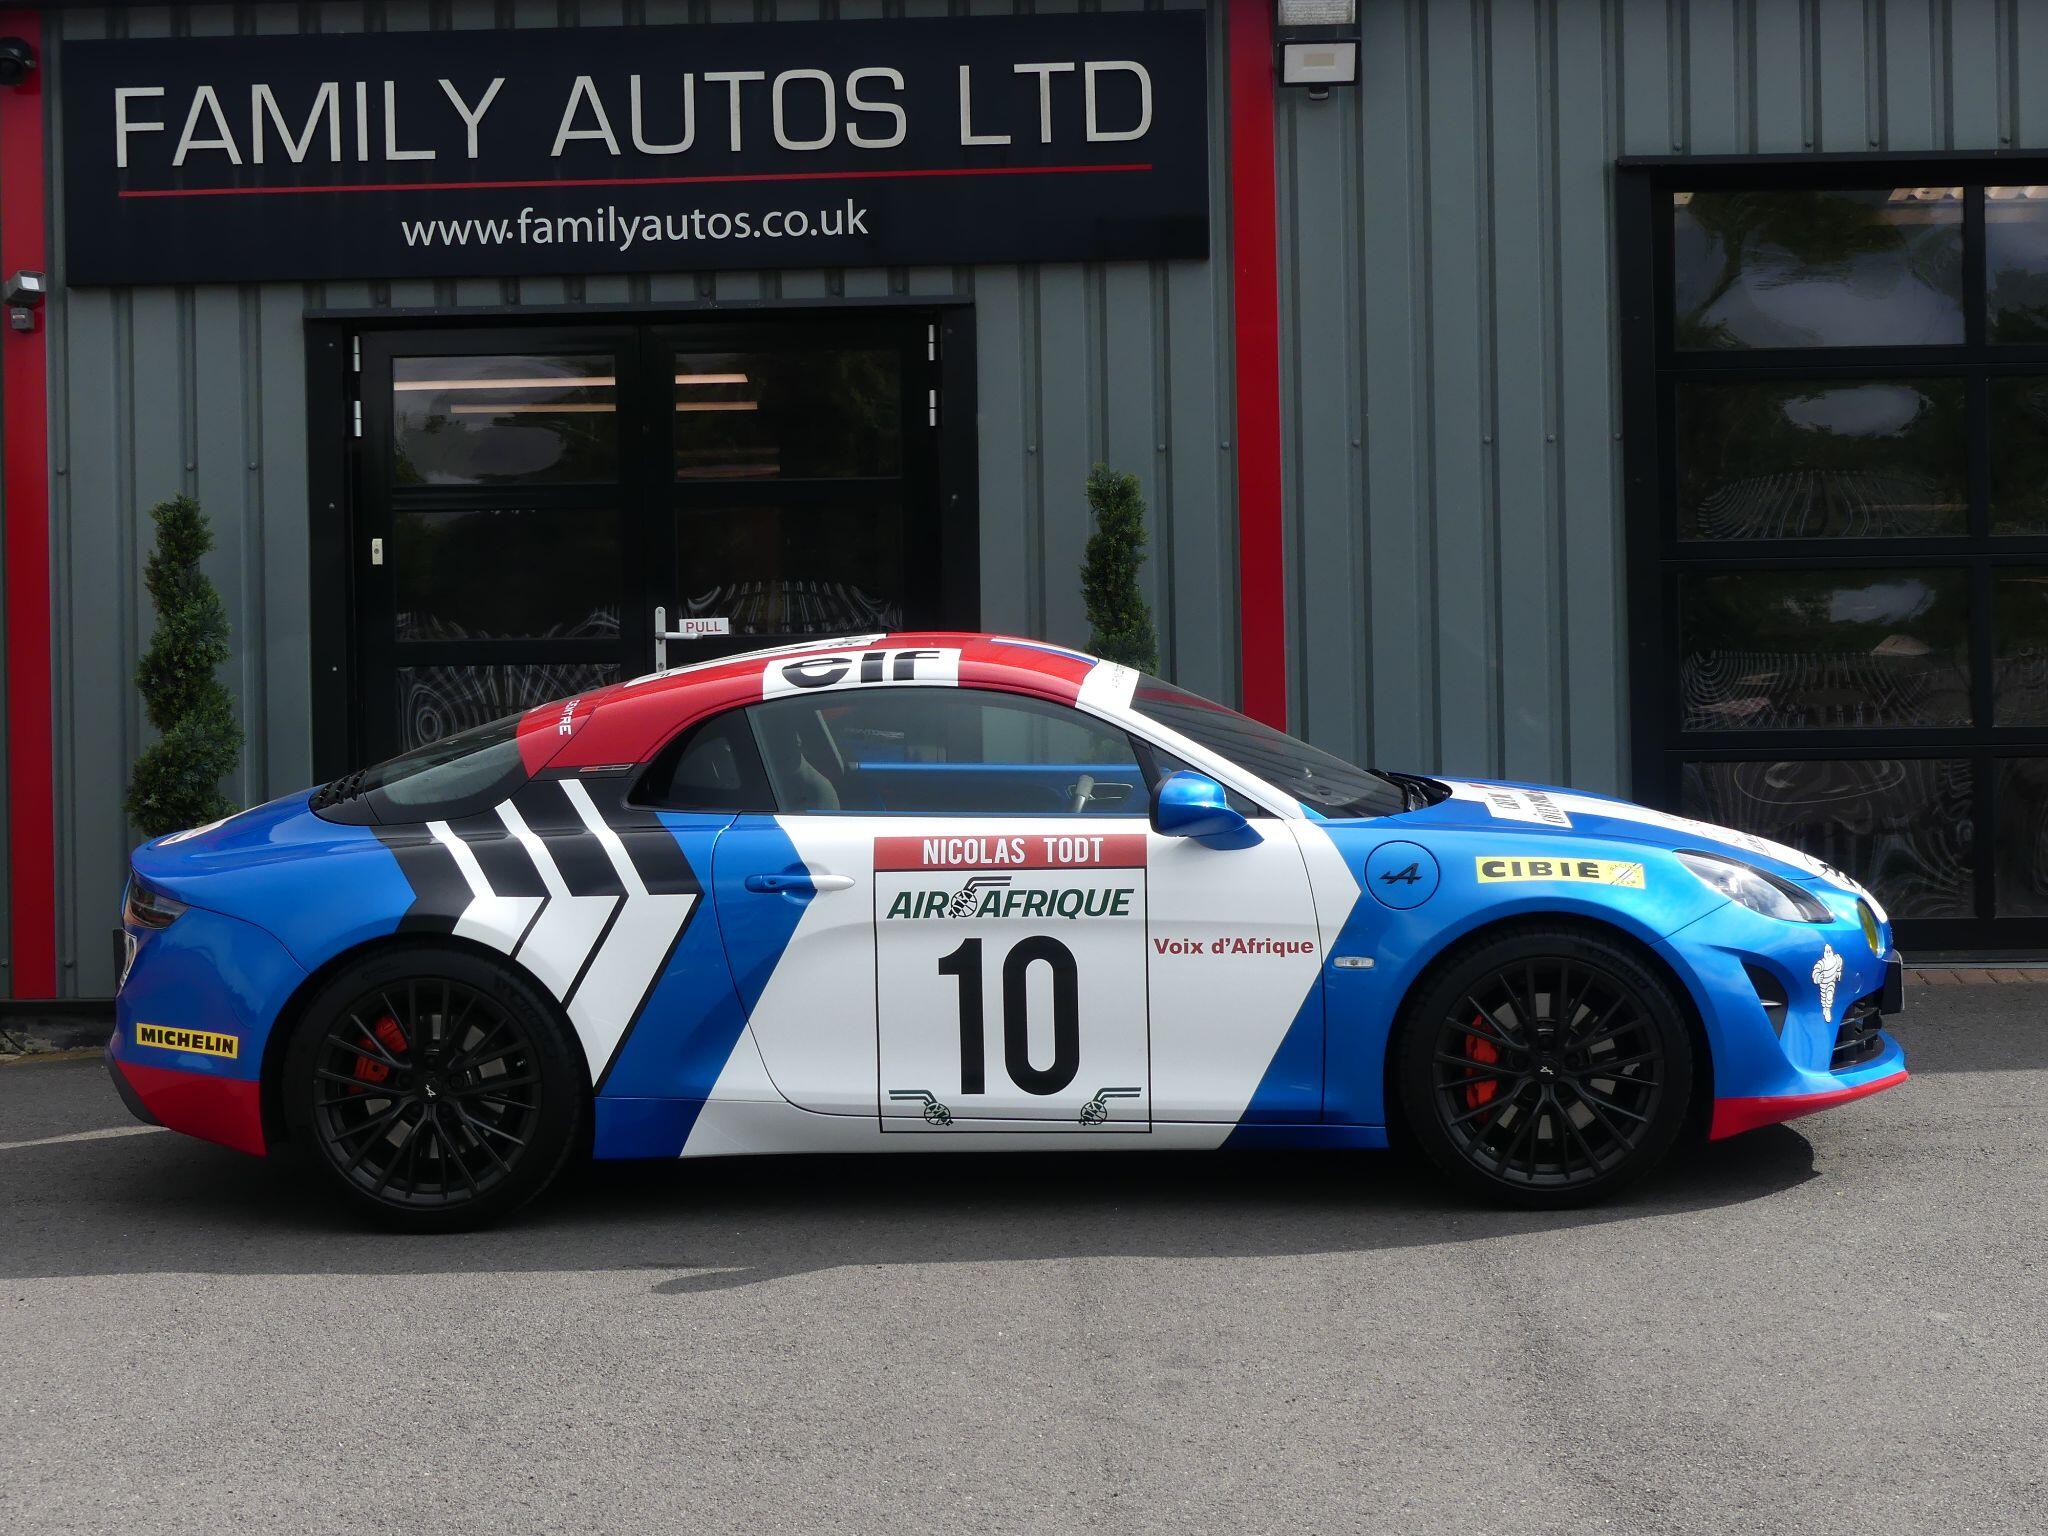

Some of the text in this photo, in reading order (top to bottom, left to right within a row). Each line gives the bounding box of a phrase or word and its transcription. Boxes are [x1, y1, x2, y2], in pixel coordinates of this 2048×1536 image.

[115, 60, 1153, 168] FAMILY AUTOS LTD
[401, 198, 869, 252] www.familyautos.co.uk
[685, 621, 723, 633] PULL
[782, 651, 940, 688] elf
[923, 837, 1105, 865] NICOLAS TODT
[887, 888, 1135, 920] AIR AFRIQUE
[1153, 938, 1314, 958] Voix d'Afrique
[938, 935, 1080, 1096] 10
[141, 1027, 234, 1054] MICHELIN
